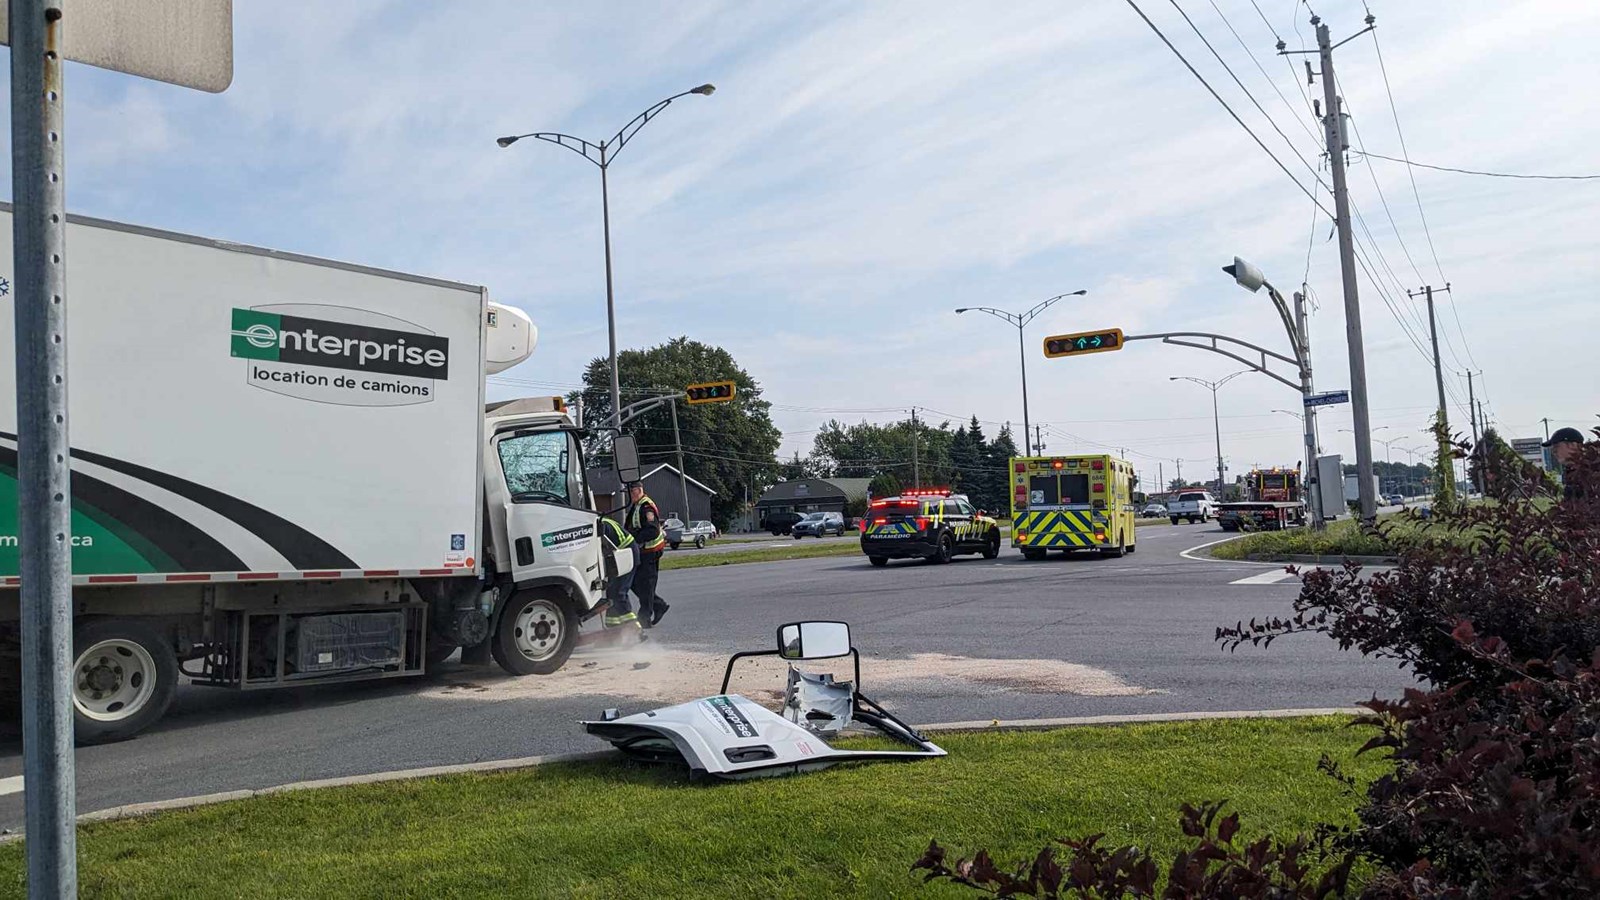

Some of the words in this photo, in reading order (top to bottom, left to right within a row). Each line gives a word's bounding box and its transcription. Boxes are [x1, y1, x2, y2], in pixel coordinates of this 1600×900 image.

[231, 323, 446, 367] enterprise
[253, 366, 329, 387] location
[333, 375, 356, 389] de
[361, 380, 429, 396] camions
[541, 527, 593, 543] enterprise
[714, 697, 752, 737] enterprise
